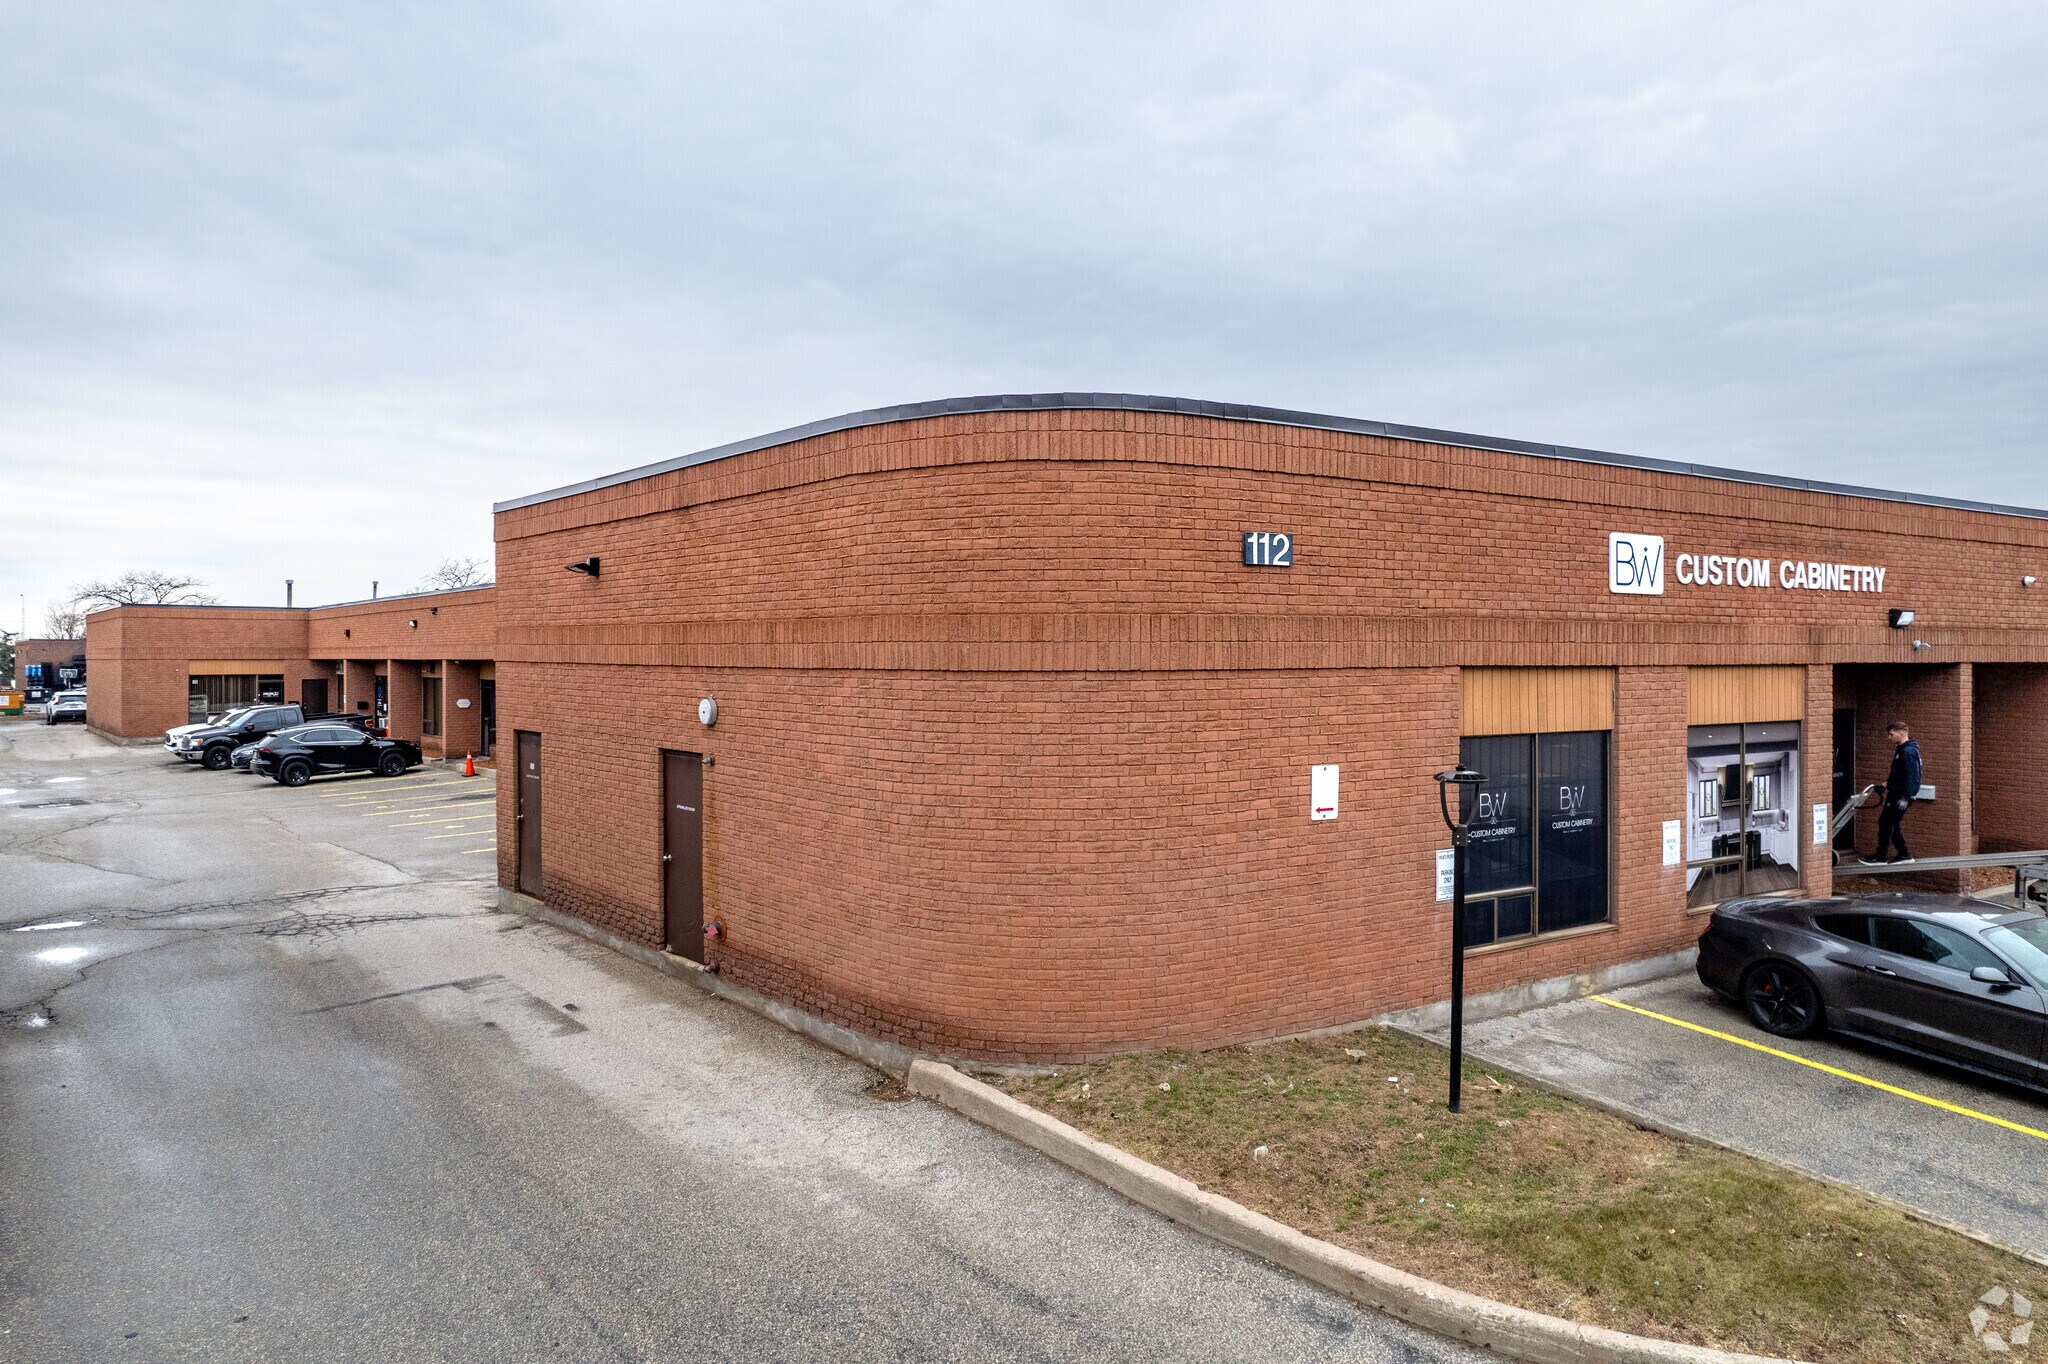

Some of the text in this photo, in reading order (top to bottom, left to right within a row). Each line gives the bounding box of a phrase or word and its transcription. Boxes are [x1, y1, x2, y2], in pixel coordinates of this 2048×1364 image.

[1247, 532, 1290, 566] 112
[1676, 553, 1886, 593] CUSTOM CABINETRY
[1470, 826, 1517, 838] CUSTOM CABINETRY
[1551, 818, 1594, 830] CUSTOM CABINETRY
